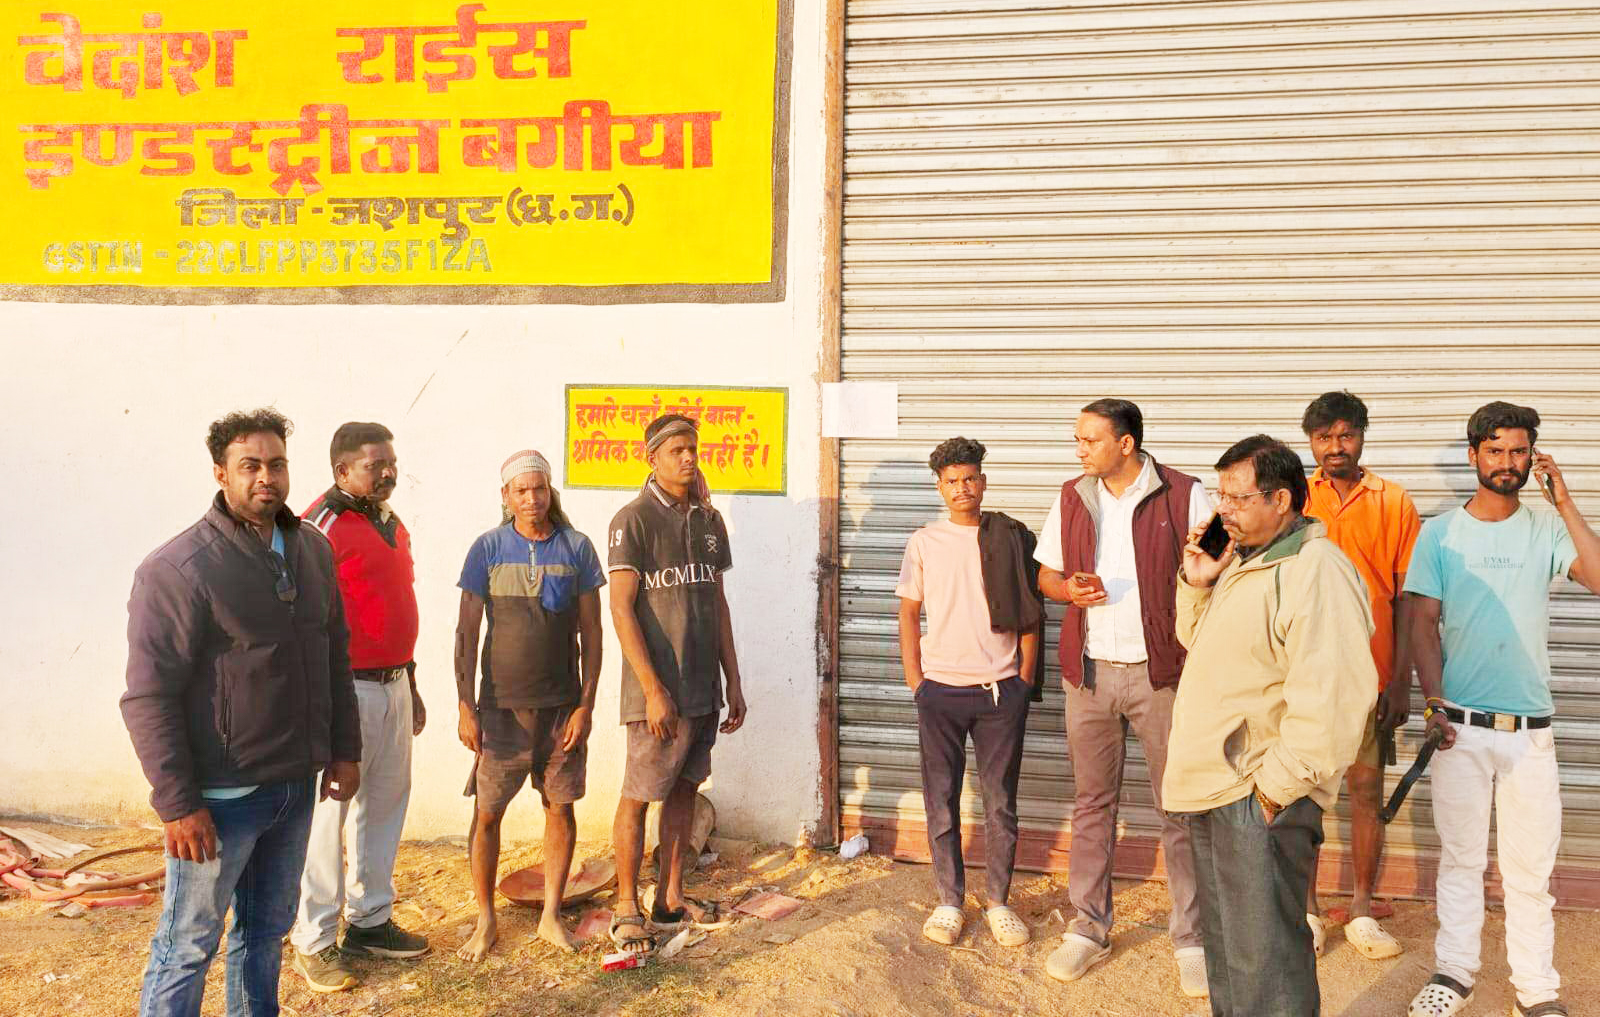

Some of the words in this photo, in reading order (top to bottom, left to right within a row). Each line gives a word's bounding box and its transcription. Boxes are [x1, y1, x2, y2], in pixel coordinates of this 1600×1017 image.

[17, 12, 248, 99] वेदांश
[336, 3, 587, 93] राईस
[18, 103, 451, 196] इण्डस्ट्रीज
[461, 100, 721, 173] बगीया
[175, 188, 305, 229] जिला
[43, 240, 143, 274] GSTIN
[176, 238, 493, 273] 22CLFPP3735F1ZA
[575, 396, 619, 434] हमारे
[609, 528, 623, 548] 19
